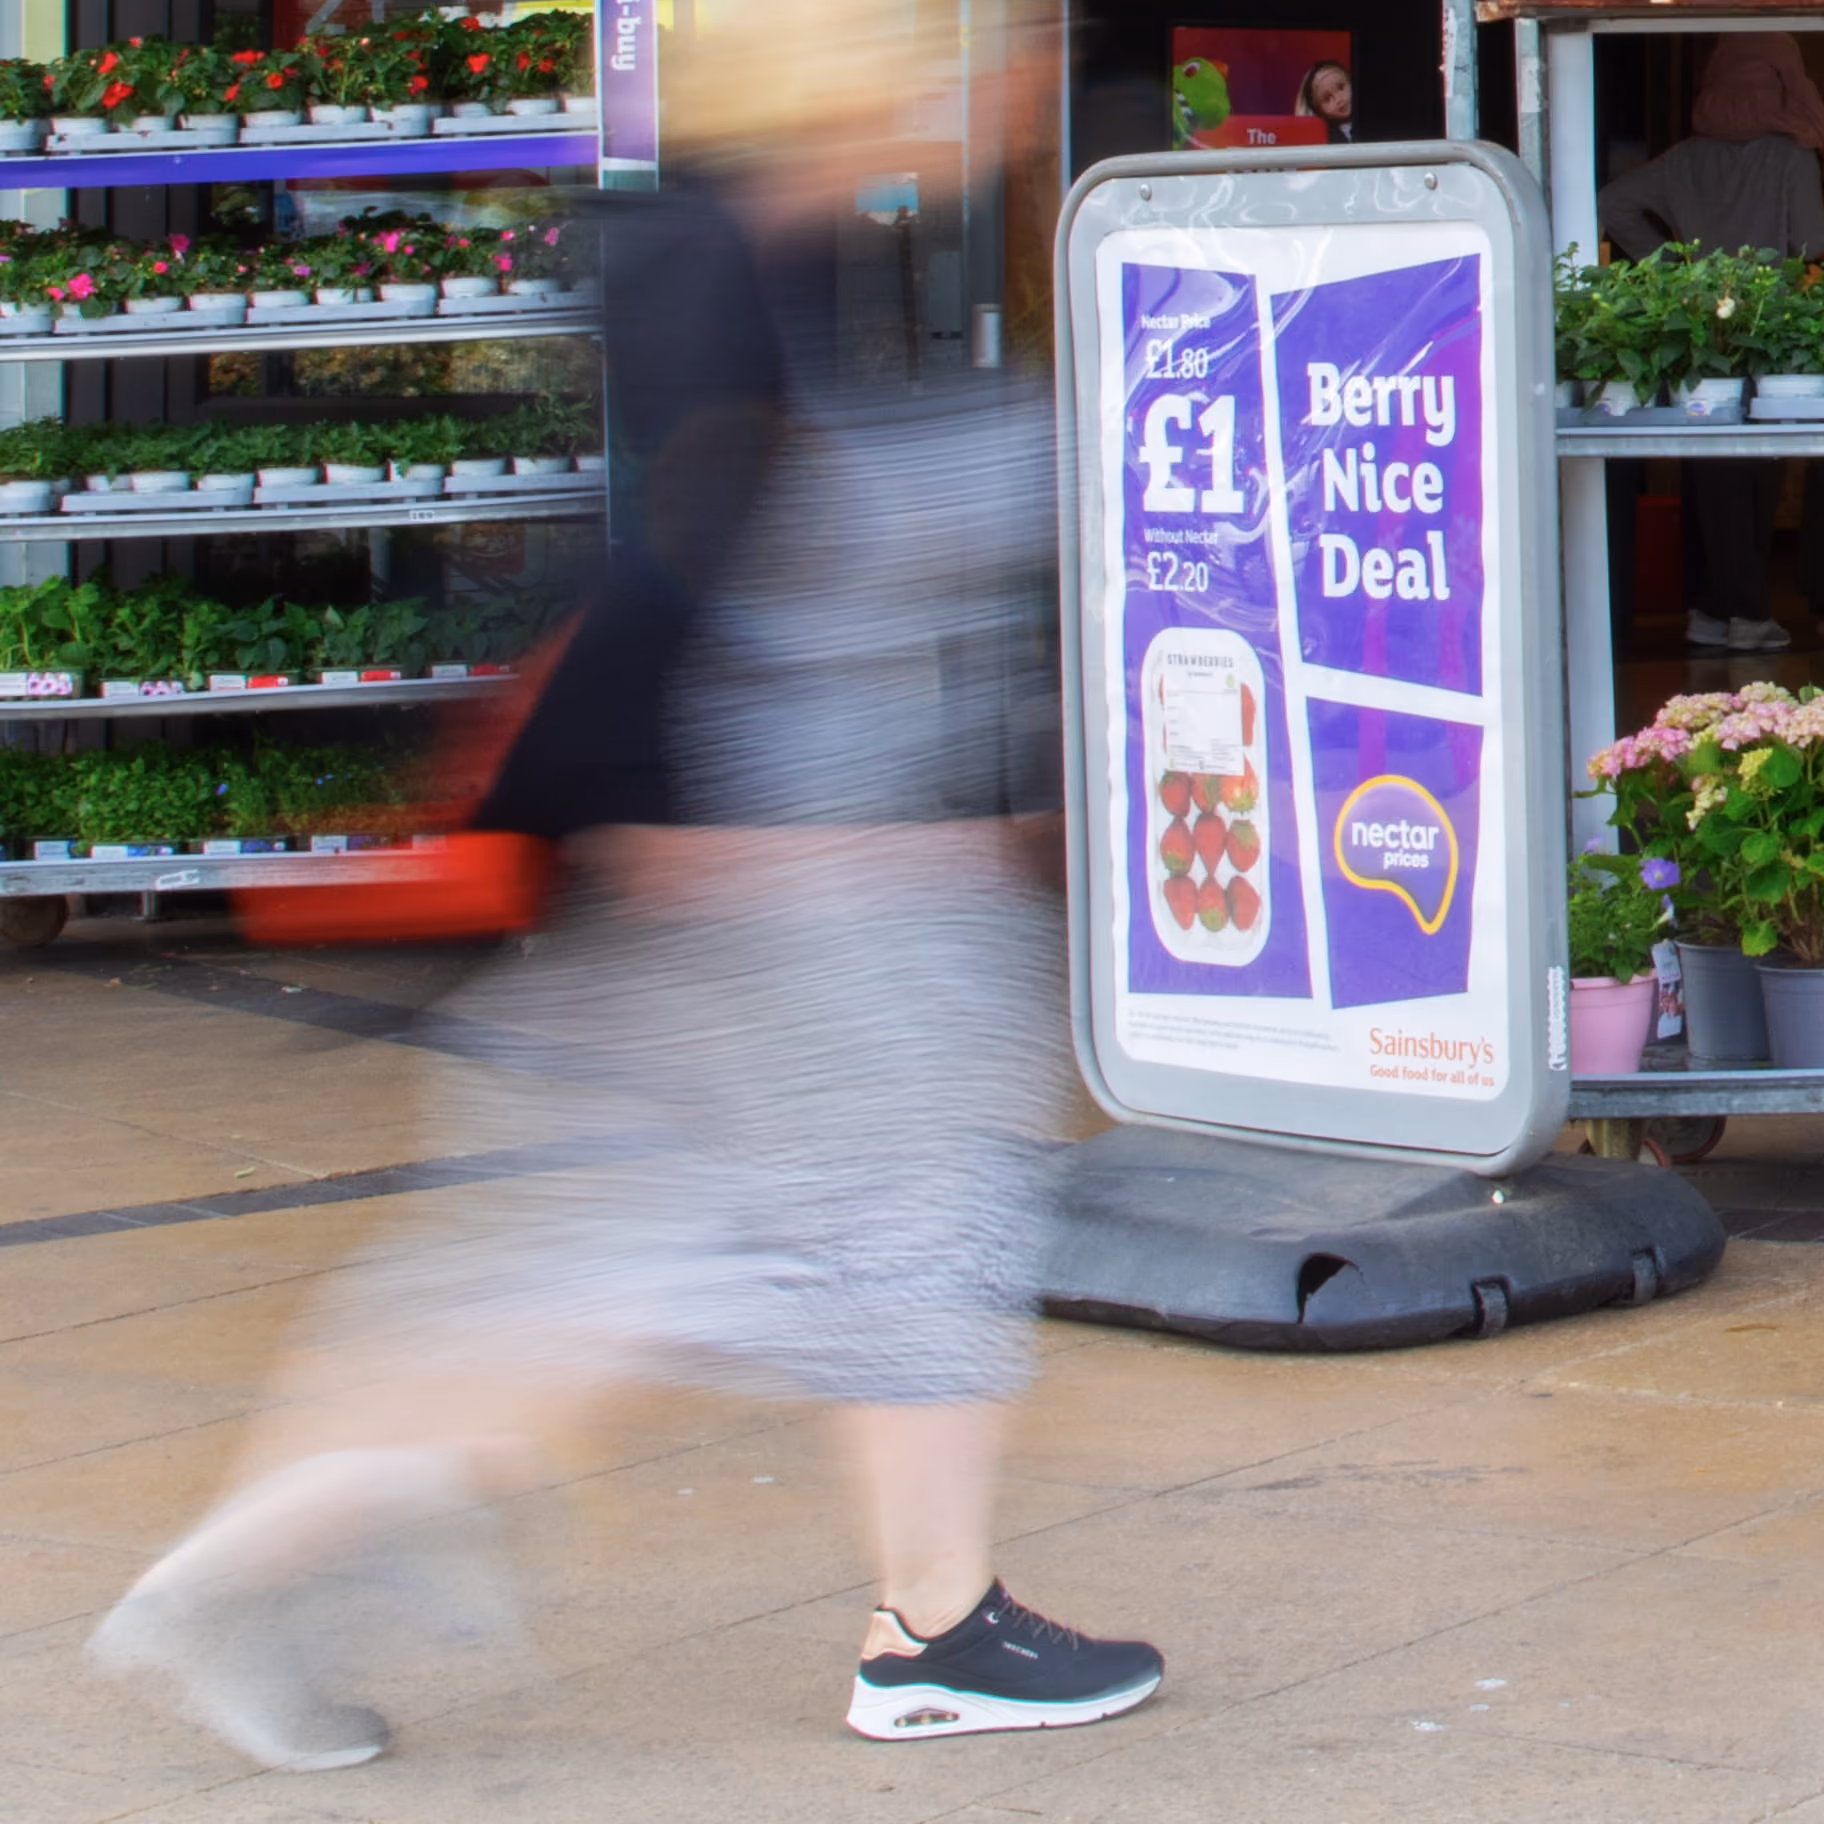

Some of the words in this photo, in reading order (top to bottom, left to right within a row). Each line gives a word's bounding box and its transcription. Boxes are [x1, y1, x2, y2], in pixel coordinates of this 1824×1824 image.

[1246, 128, 1277, 144] The
[1145, 337, 1210, 379] £1.80
[1306, 361, 1456, 448] Berry
[1139, 391, 1245, 514] £1
[1322, 443, 1444, 514] Nice
[1144, 528, 1184, 545] Without
[1185, 529, 1219, 546] Nectar
[1146, 550, 1209, 594] £2.20
[1320, 529, 1451, 600] Deal
[1166, 653, 1235, 669] STRAWBERRIES
[1351, 819, 1439, 851] nectar
[1382, 849, 1430, 871] prices
[1369, 1026, 1495, 1065] Sainsbury's
[1370, 1064, 1399, 1081] Good
[1401, 1065, 1429, 1082] food
[1430, 1068, 1449, 1084] for
[1450, 1070, 1465, 1084] all
[1467, 1071, 1480, 1086] of
[1481, 1076, 1495, 1086] us
